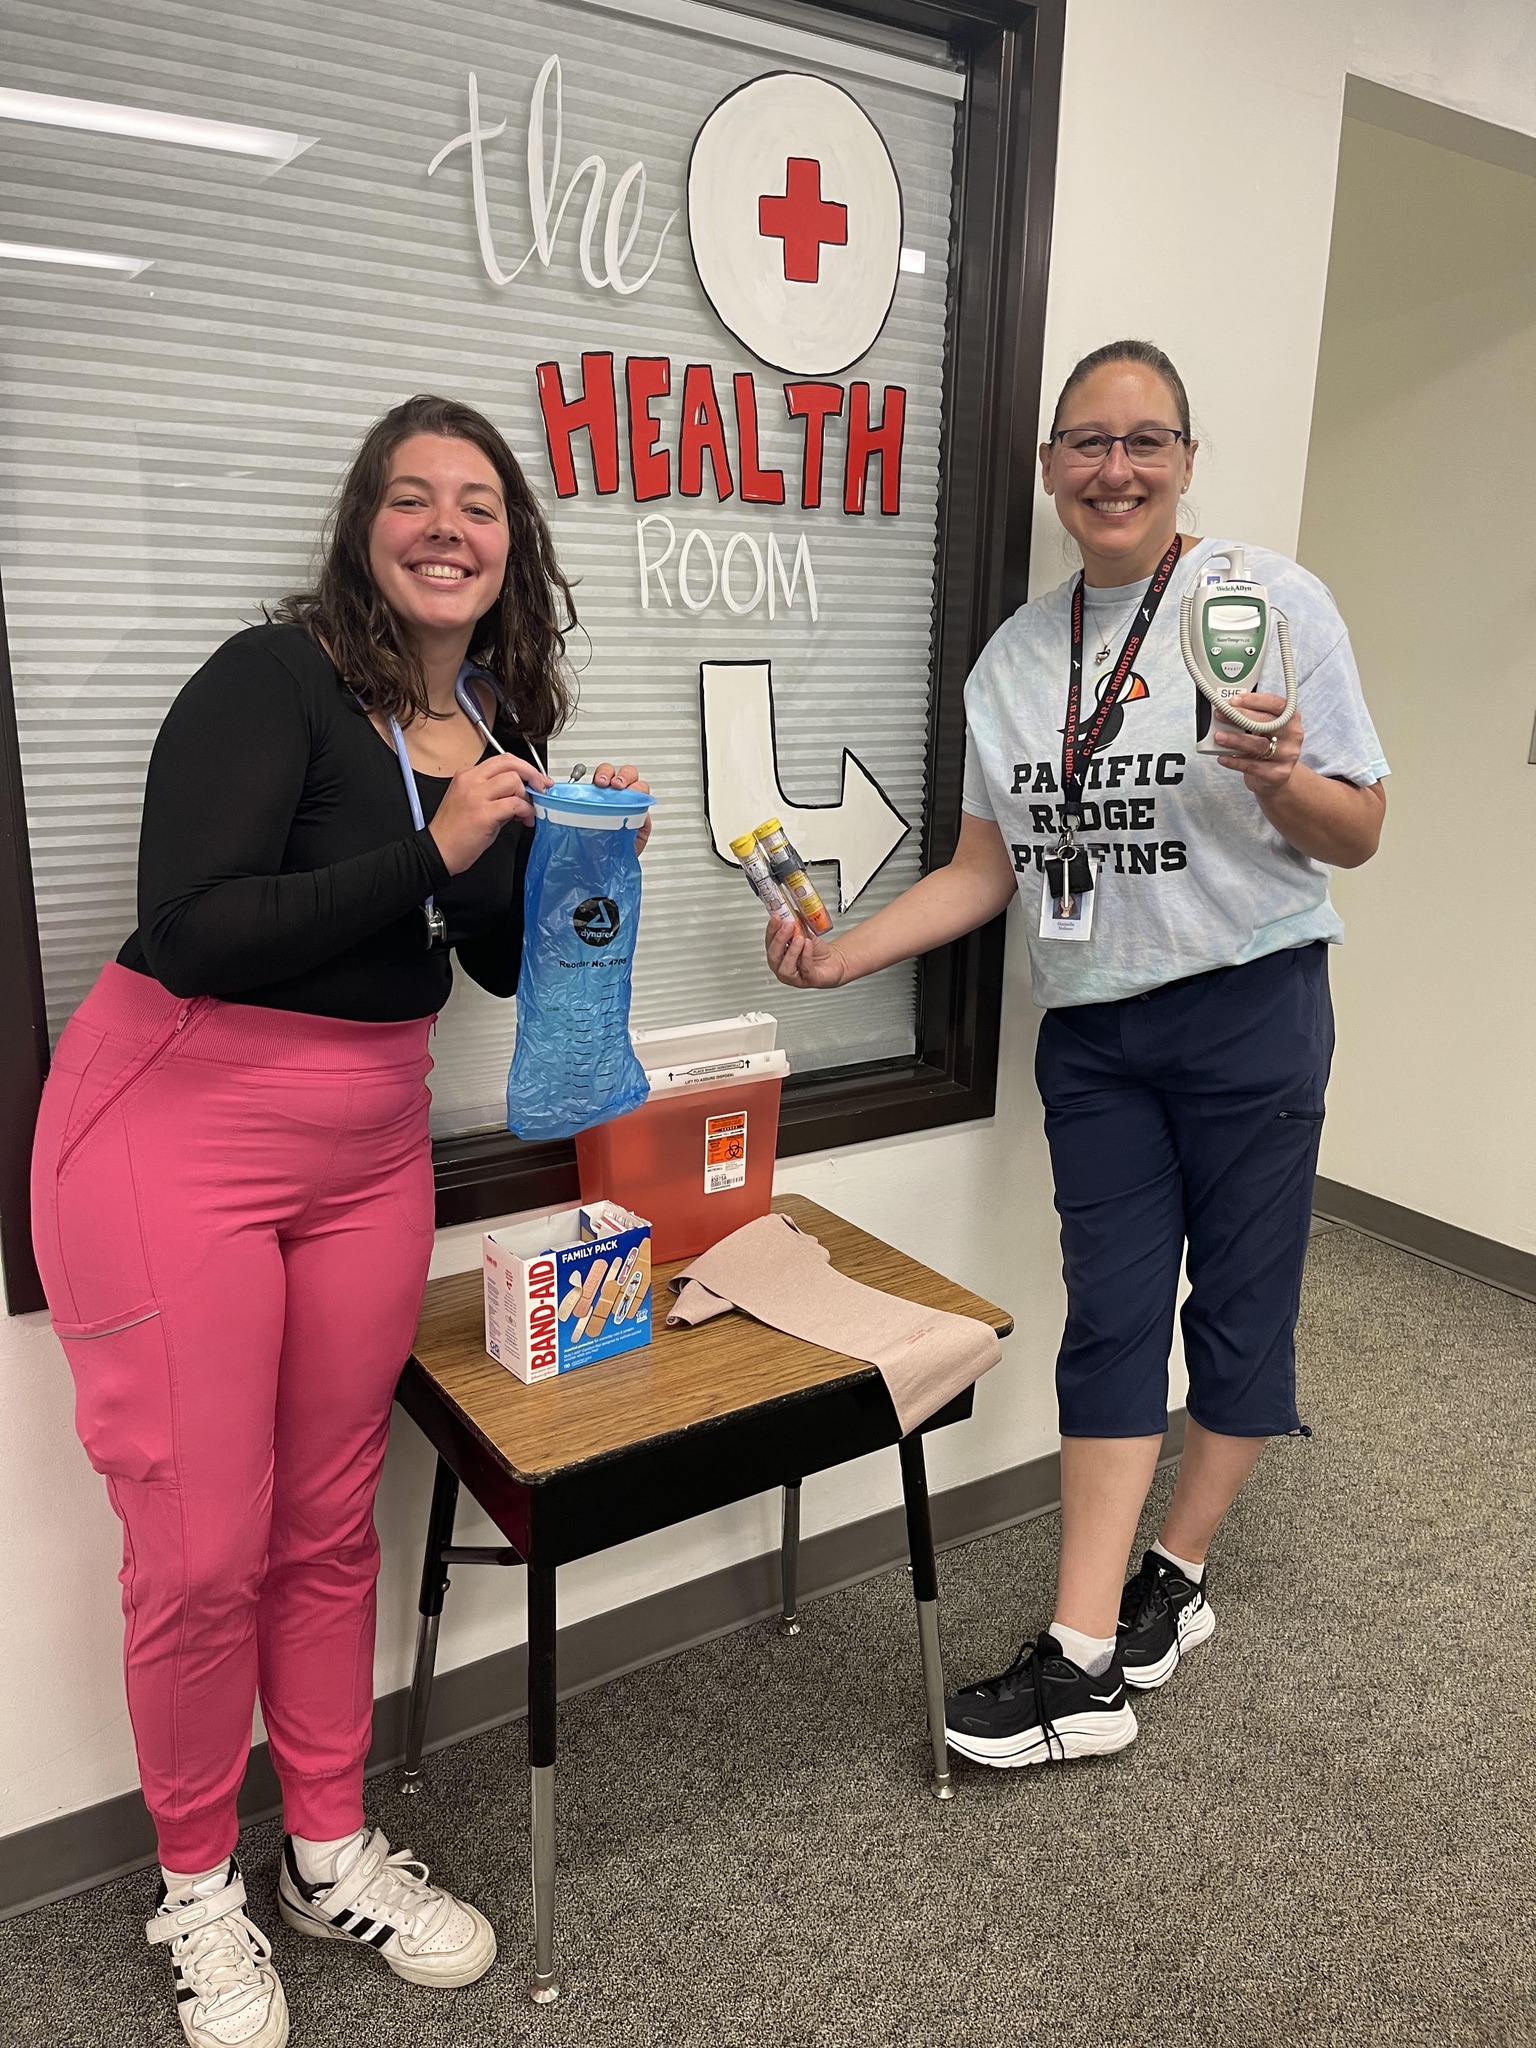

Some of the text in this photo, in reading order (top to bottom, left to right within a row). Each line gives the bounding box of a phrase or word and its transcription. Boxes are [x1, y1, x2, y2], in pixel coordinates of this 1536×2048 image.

[427, 53, 679, 295] the
[535, 350, 907, 516] HEALTH
[636, 513, 819, 623] ROOM
[1111, 636, 1140, 690] ROBOTICS
[1010, 753, 1186, 794] PAIFIC
[1011, 840, 1188, 875] PFINS
[560, 960, 590, 968] Reorder
[591, 960, 607, 968] No.
[561, 1239, 618, 1264] FAMILY PACK
[529, 1260, 556, 1371] BAND-AID
